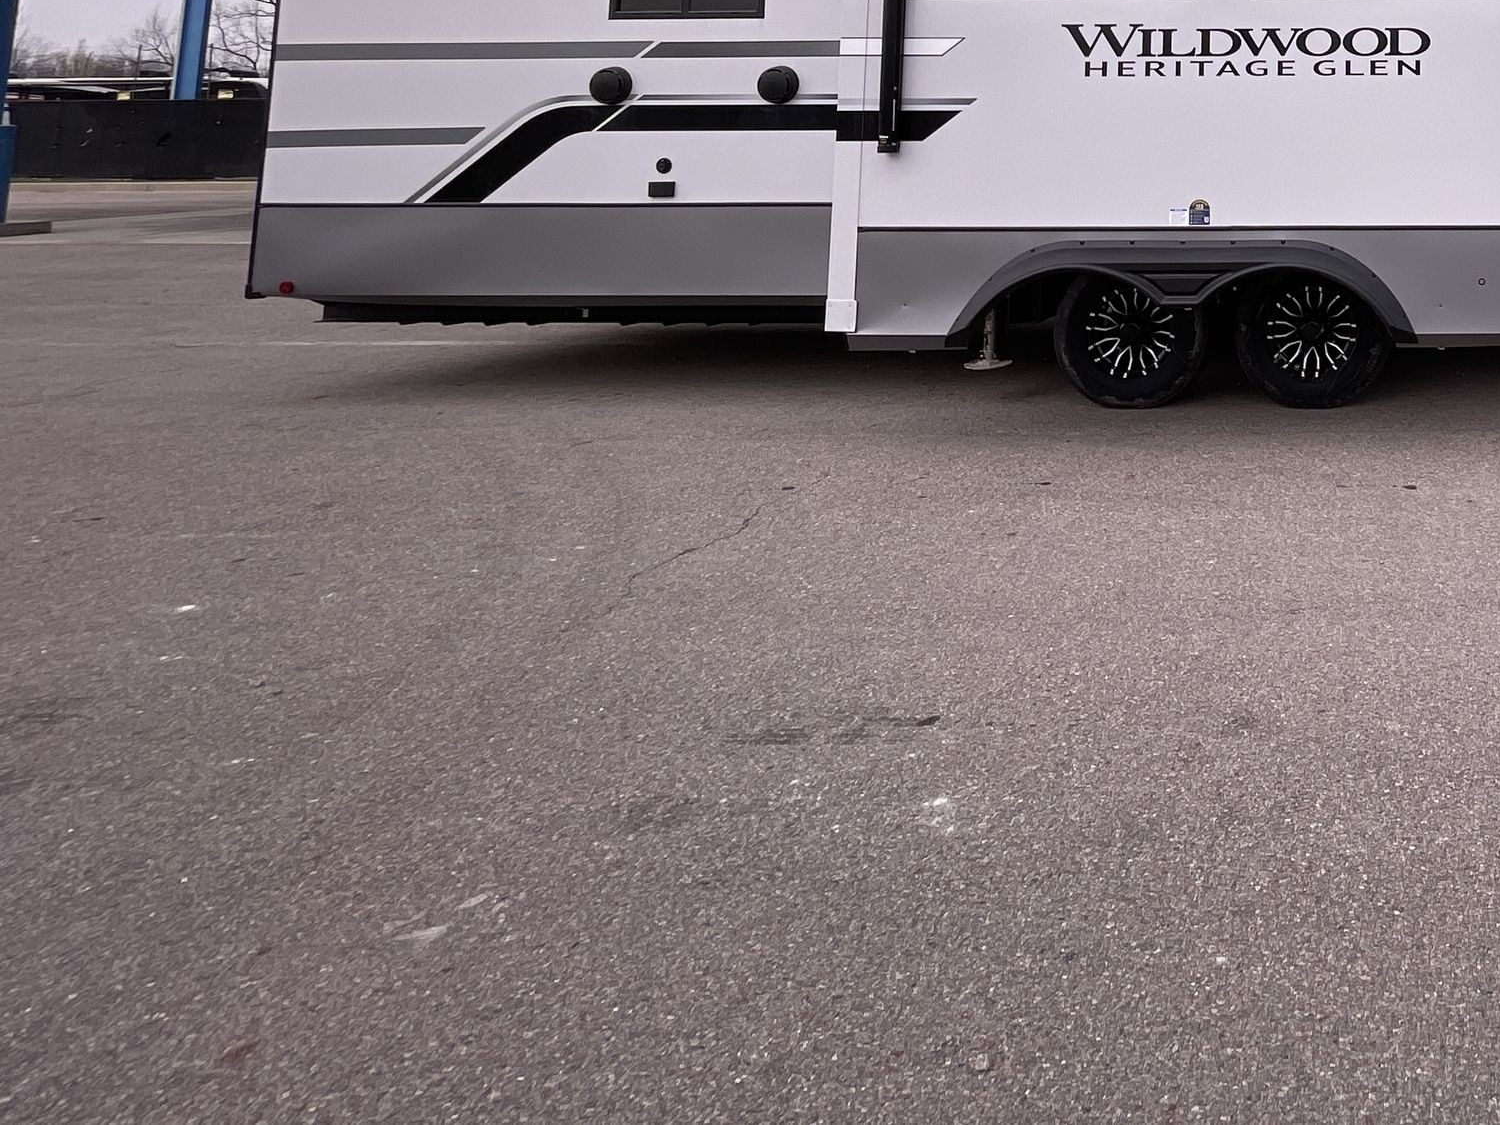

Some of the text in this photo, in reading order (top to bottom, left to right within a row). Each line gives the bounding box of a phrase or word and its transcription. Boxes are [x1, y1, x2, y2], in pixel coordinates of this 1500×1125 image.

[1061, 22, 1432, 58] WILDWOOD
[1083, 59, 1422, 77] HERITAGE GLEN
